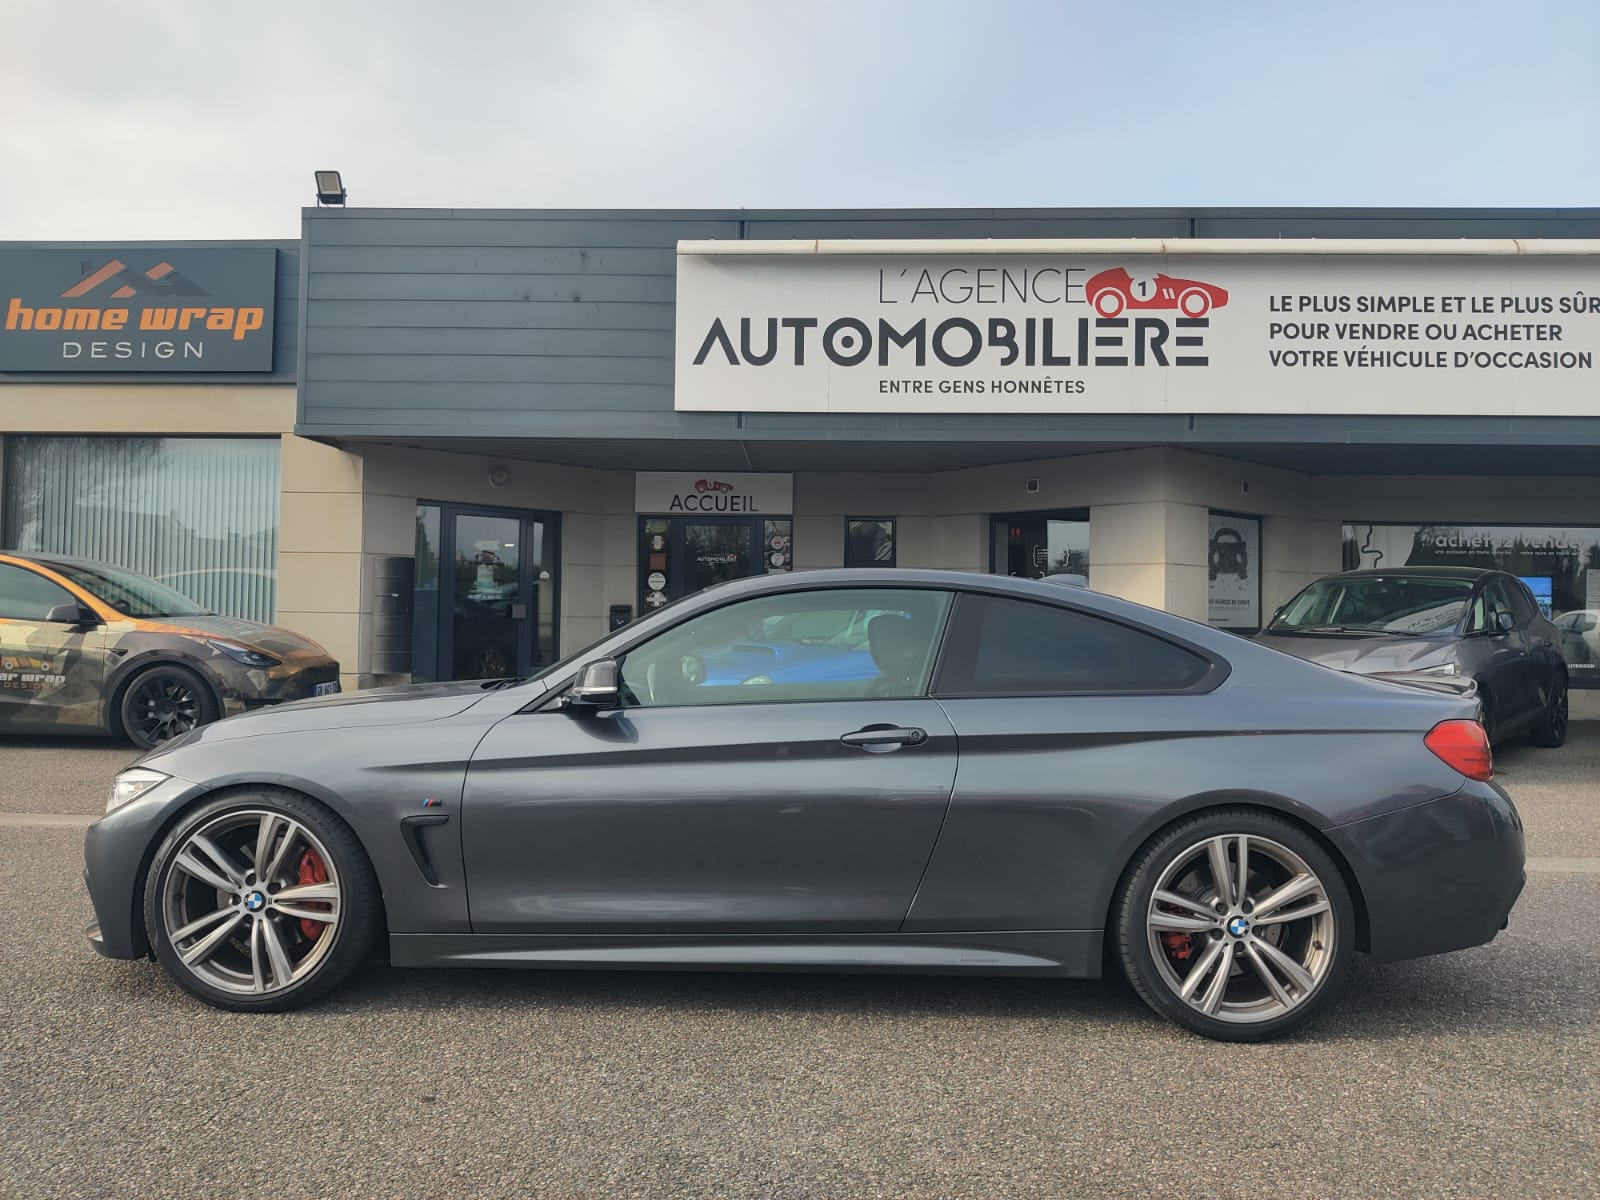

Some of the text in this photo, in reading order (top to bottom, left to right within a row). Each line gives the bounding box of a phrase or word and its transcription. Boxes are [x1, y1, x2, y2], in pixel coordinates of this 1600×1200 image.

[879, 268, 1085, 304] L'AGENCE
[1137, 280, 1147, 297] 1
[1269, 290, 1600, 314] LE PLUS SIMPLE ET LE PLUS SÛR
[5, 298, 264, 340] home wrap
[1269, 322, 1562, 341] POUR VENDRE OU ACHETER
[62, 341, 203, 358] DESIGN
[693, 316, 1210, 367] AUTOMOBILIERE
[1268, 345, 1592, 369] VOTRE VÉHICULE D'OCCASION
[879, 375, 1085, 394] ENTRE GENS HONNÊTES
[669, 494, 759, 512] ACCUEIL
[21, 673, 66, 686] wrap
